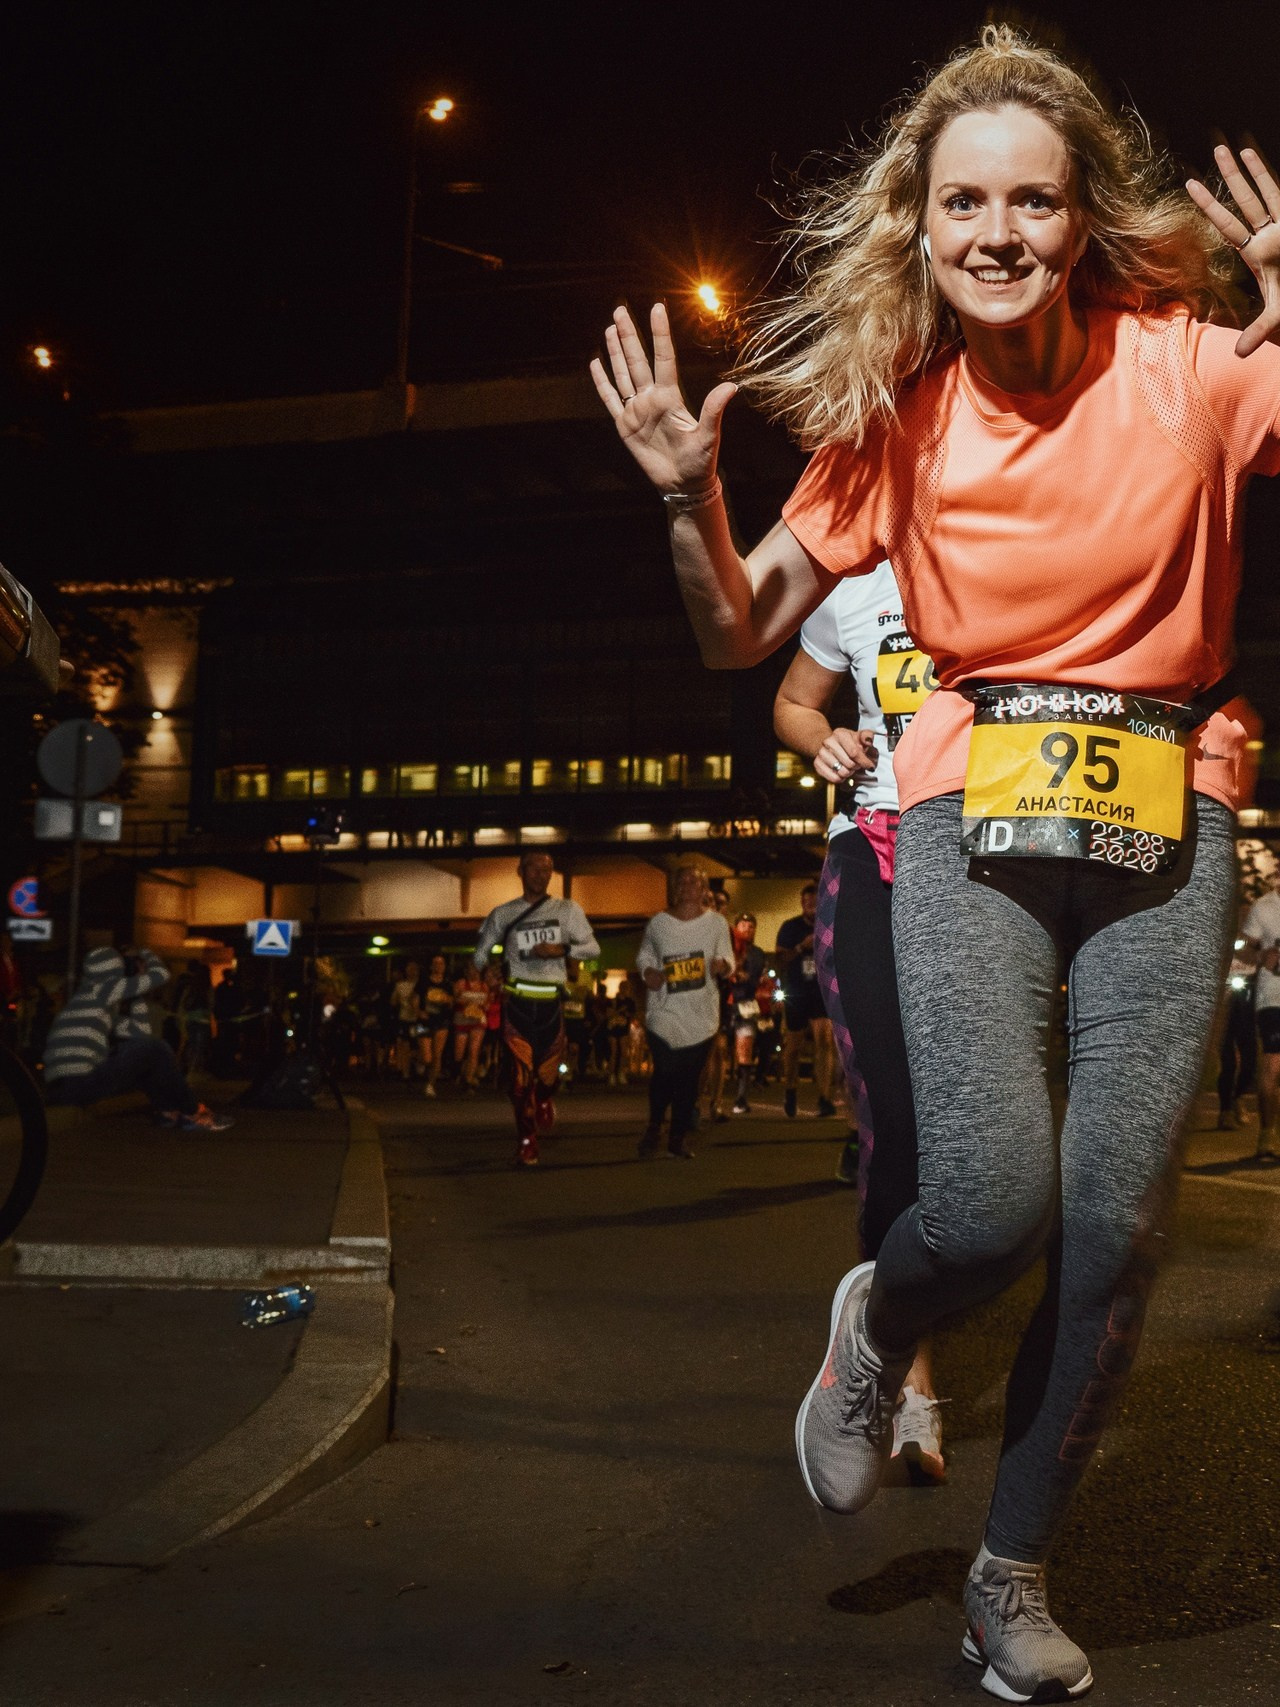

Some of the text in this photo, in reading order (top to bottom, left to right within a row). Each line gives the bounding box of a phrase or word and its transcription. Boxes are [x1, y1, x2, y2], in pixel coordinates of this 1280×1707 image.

[1053, 713, 1103, 721] ЗАБЕГ
[1040, 731, 1120, 793] 95
[1015, 796, 1135, 823] АНАСТАСИЯ
[987, 820, 1014, 852] D
[1088, 840, 1158, 873] 2020
[524, 928, 556, 943] 1103
